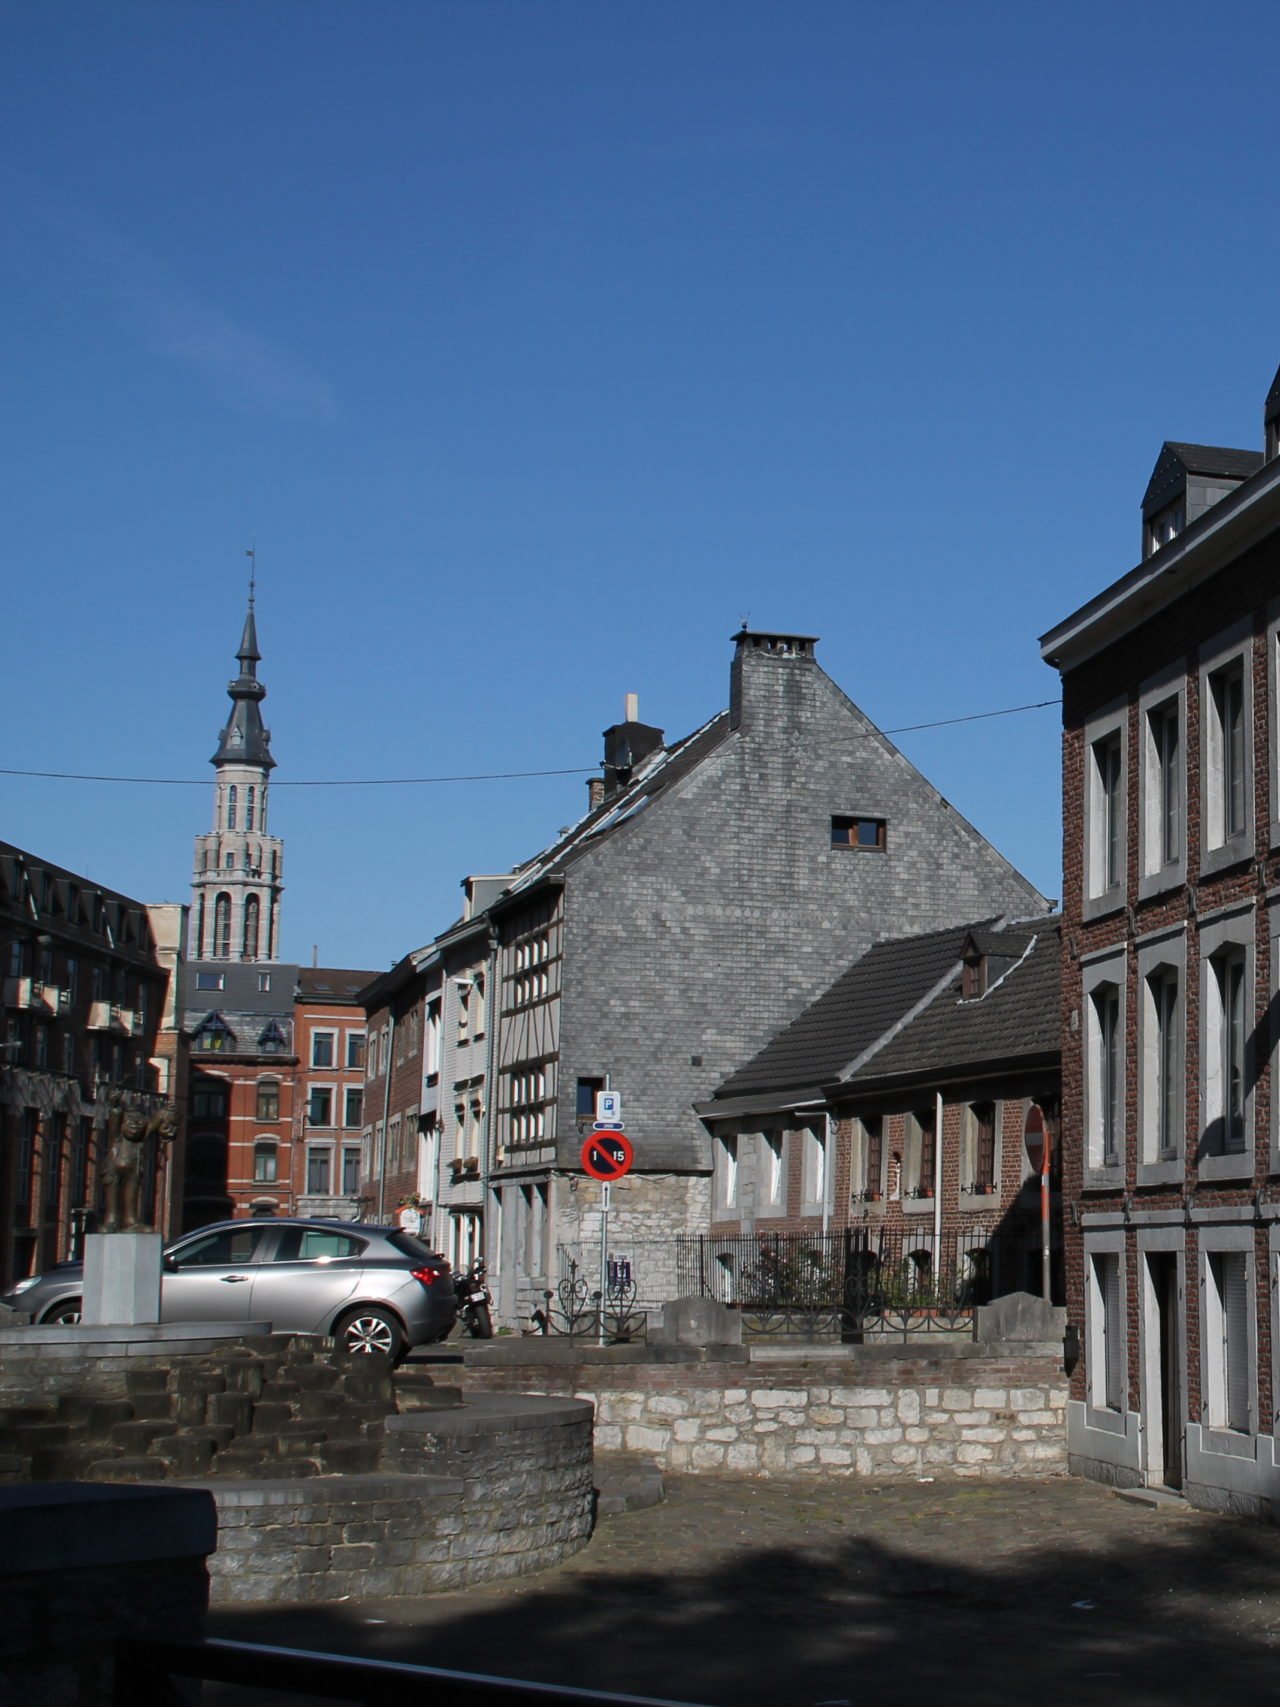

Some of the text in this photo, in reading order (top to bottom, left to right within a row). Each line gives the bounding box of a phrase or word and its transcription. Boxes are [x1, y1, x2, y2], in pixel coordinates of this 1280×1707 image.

[605, 1100, 613, 1109] P
[593, 1150, 625, 1161] 1 15
